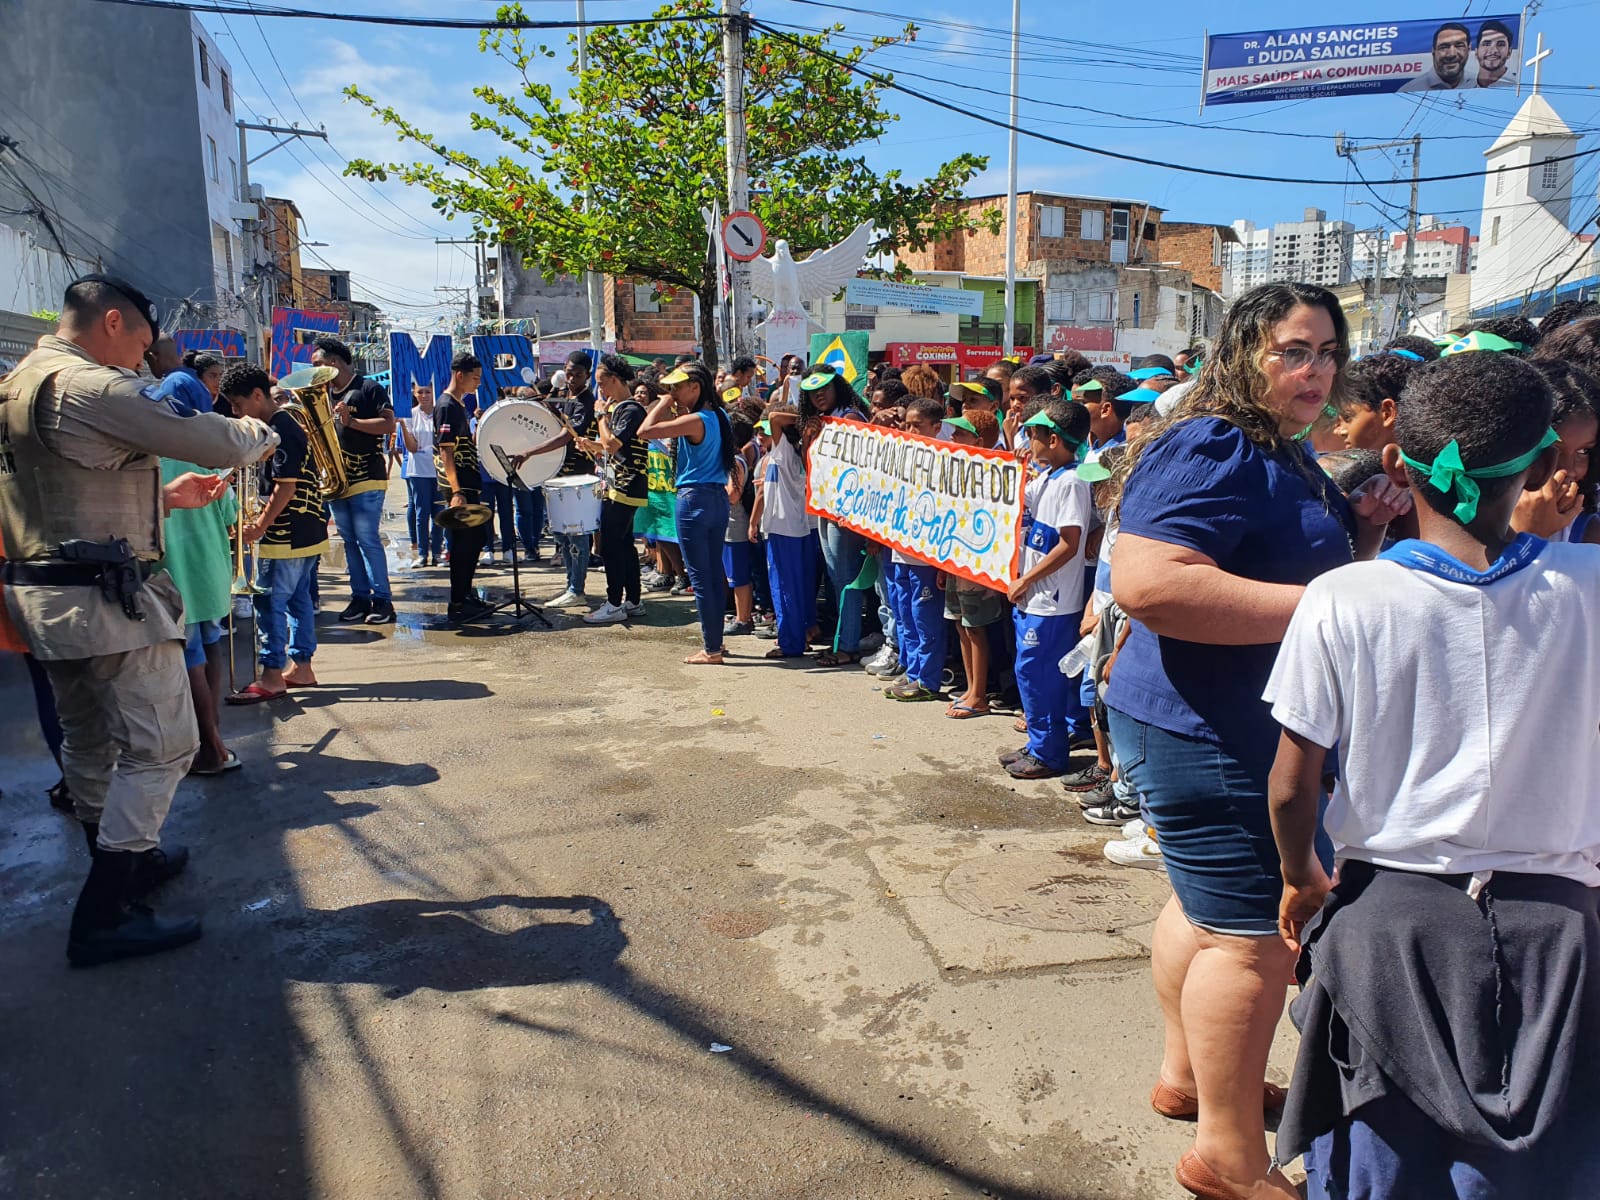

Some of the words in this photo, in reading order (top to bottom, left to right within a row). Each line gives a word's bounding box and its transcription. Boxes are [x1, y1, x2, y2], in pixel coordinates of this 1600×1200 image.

[1243, 40, 1260, 50] DR.
[1264, 31, 1313, 48] ALAN
[1316, 26, 1399, 44] SANCHES
[1247, 55, 1255, 64] E
[1258, 47, 1307, 64] DUDA
[1311, 41, 1392, 60] SANCHES
[1216, 74, 1249, 88] MAIS
[1253, 67, 1299, 84] SAÚDE
[1303, 68, 1322, 81] NA
[1326, 61, 1423, 79] COMUNIDADE
[1311, 90, 1337, 98] SOCIAIS
[883, 283, 932, 292] ATENÇÃO
[916, 351, 958, 361] COXINHA
[517, 413, 548, 432] BRASIL
[817, 428, 875, 469] ESCOLA
[873, 441, 937, 492] MUNICIPAL
[938, 455, 985, 500] NOVA
[990, 465, 1017, 506] DO
[892, 486, 909, 535] da
[1438, 557, 1518, 583] SALVADOR
